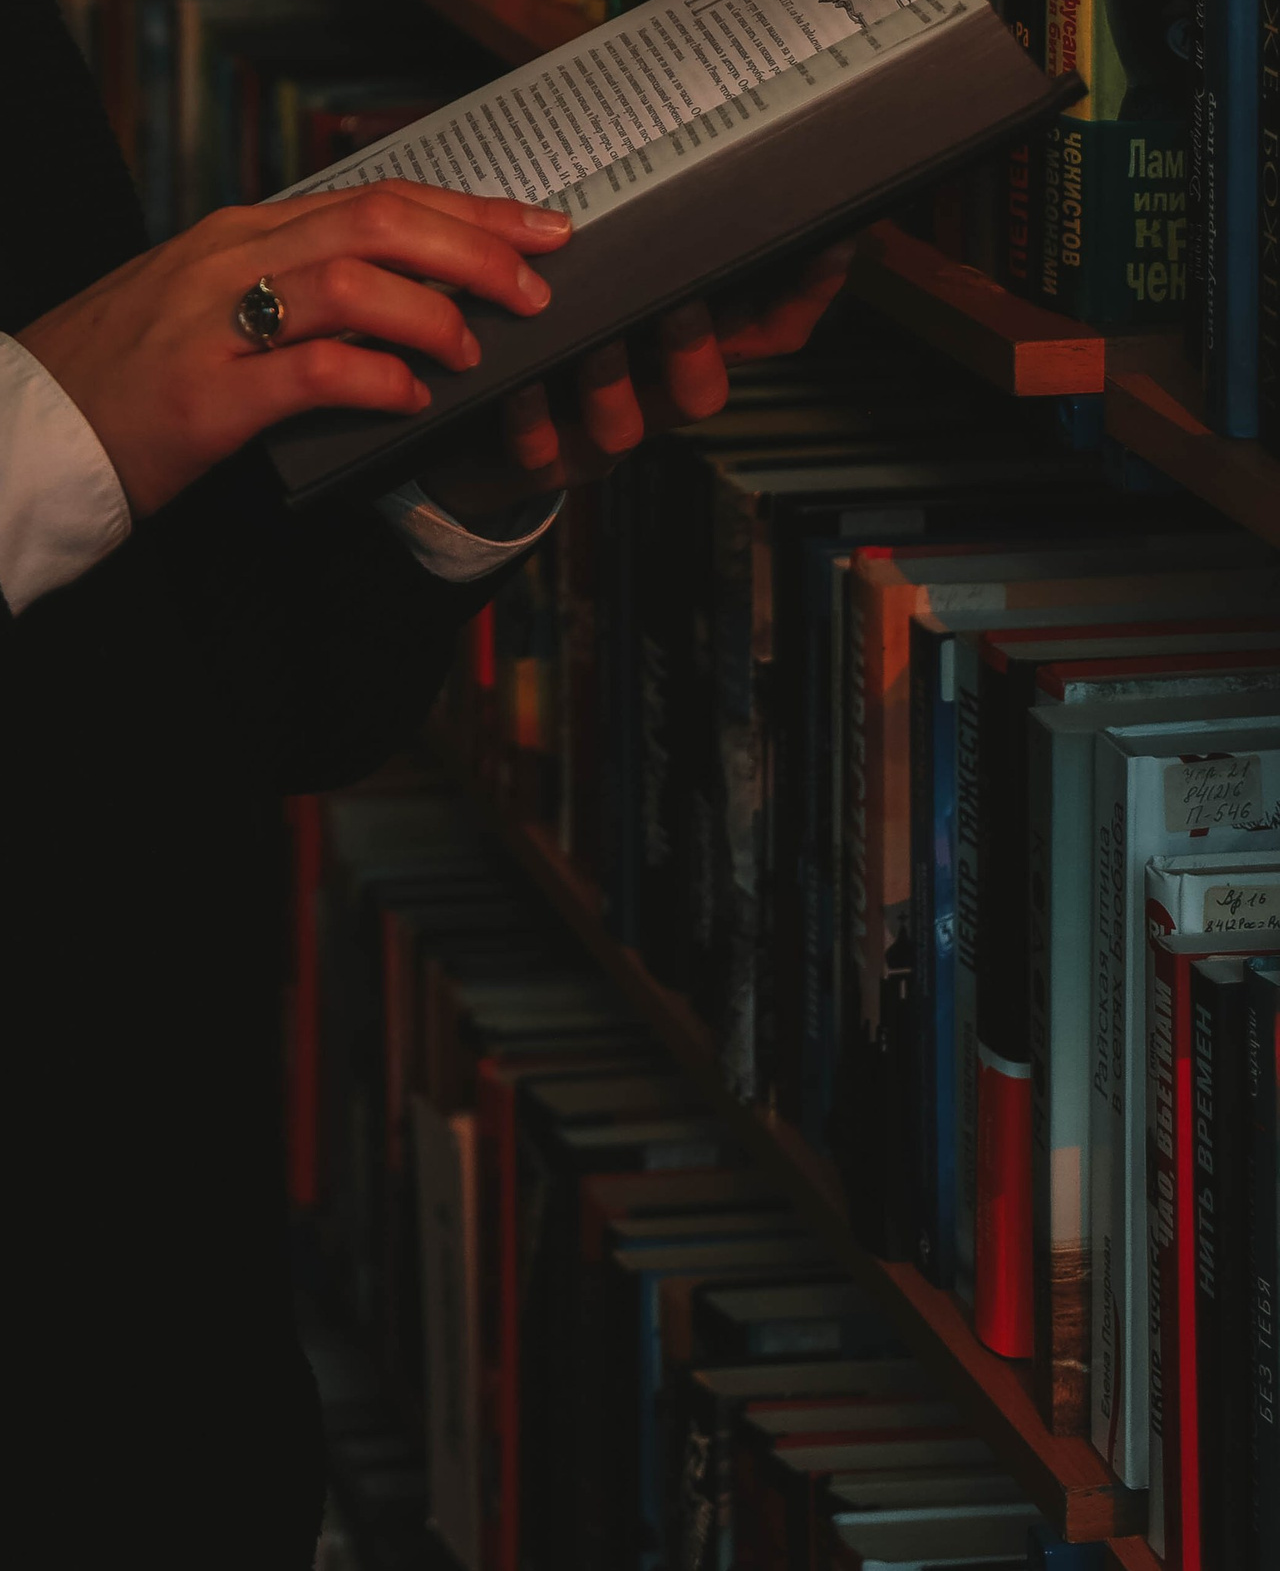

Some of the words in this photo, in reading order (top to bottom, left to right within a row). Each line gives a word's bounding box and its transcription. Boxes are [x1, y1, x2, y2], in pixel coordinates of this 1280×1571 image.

[560, 171, 569, 179] И
[1128, 138, 1187, 179] Лам
[1206, 90, 1217, 159] Петр
[524, 185, 539, 202] При
[1042, 148, 1061, 296] масонами
[1062, 131, 1083, 268] чекистов
[957, 686, 980, 850] ТЯЖЕСТИ
[957, 859, 980, 973] ЦЕНТР
[1097, 825, 1112, 939] птица
[1108, 800, 1124, 963] Баобаба
[1094, 954, 1110, 1100] Райская
[1112, 975, 1122, 1080] сетях
[1154, 976, 1175, 1161] ВЬЕТНАМ
[1111, 1091, 1122, 1116] в
[1195, 1001, 1215, 1174] ВРЕМЕН
[1156, 1170, 1175, 1247] ЧАО,
[1196, 1186, 1216, 1300] НИТЬ
[1101, 1234, 1113, 1347] Полярная
[1257, 1275, 1273, 1350] ТЕБЯ
[1100, 1351, 1112, 1420] Елена
[1258, 1364, 1274, 1425] БЕЗ
